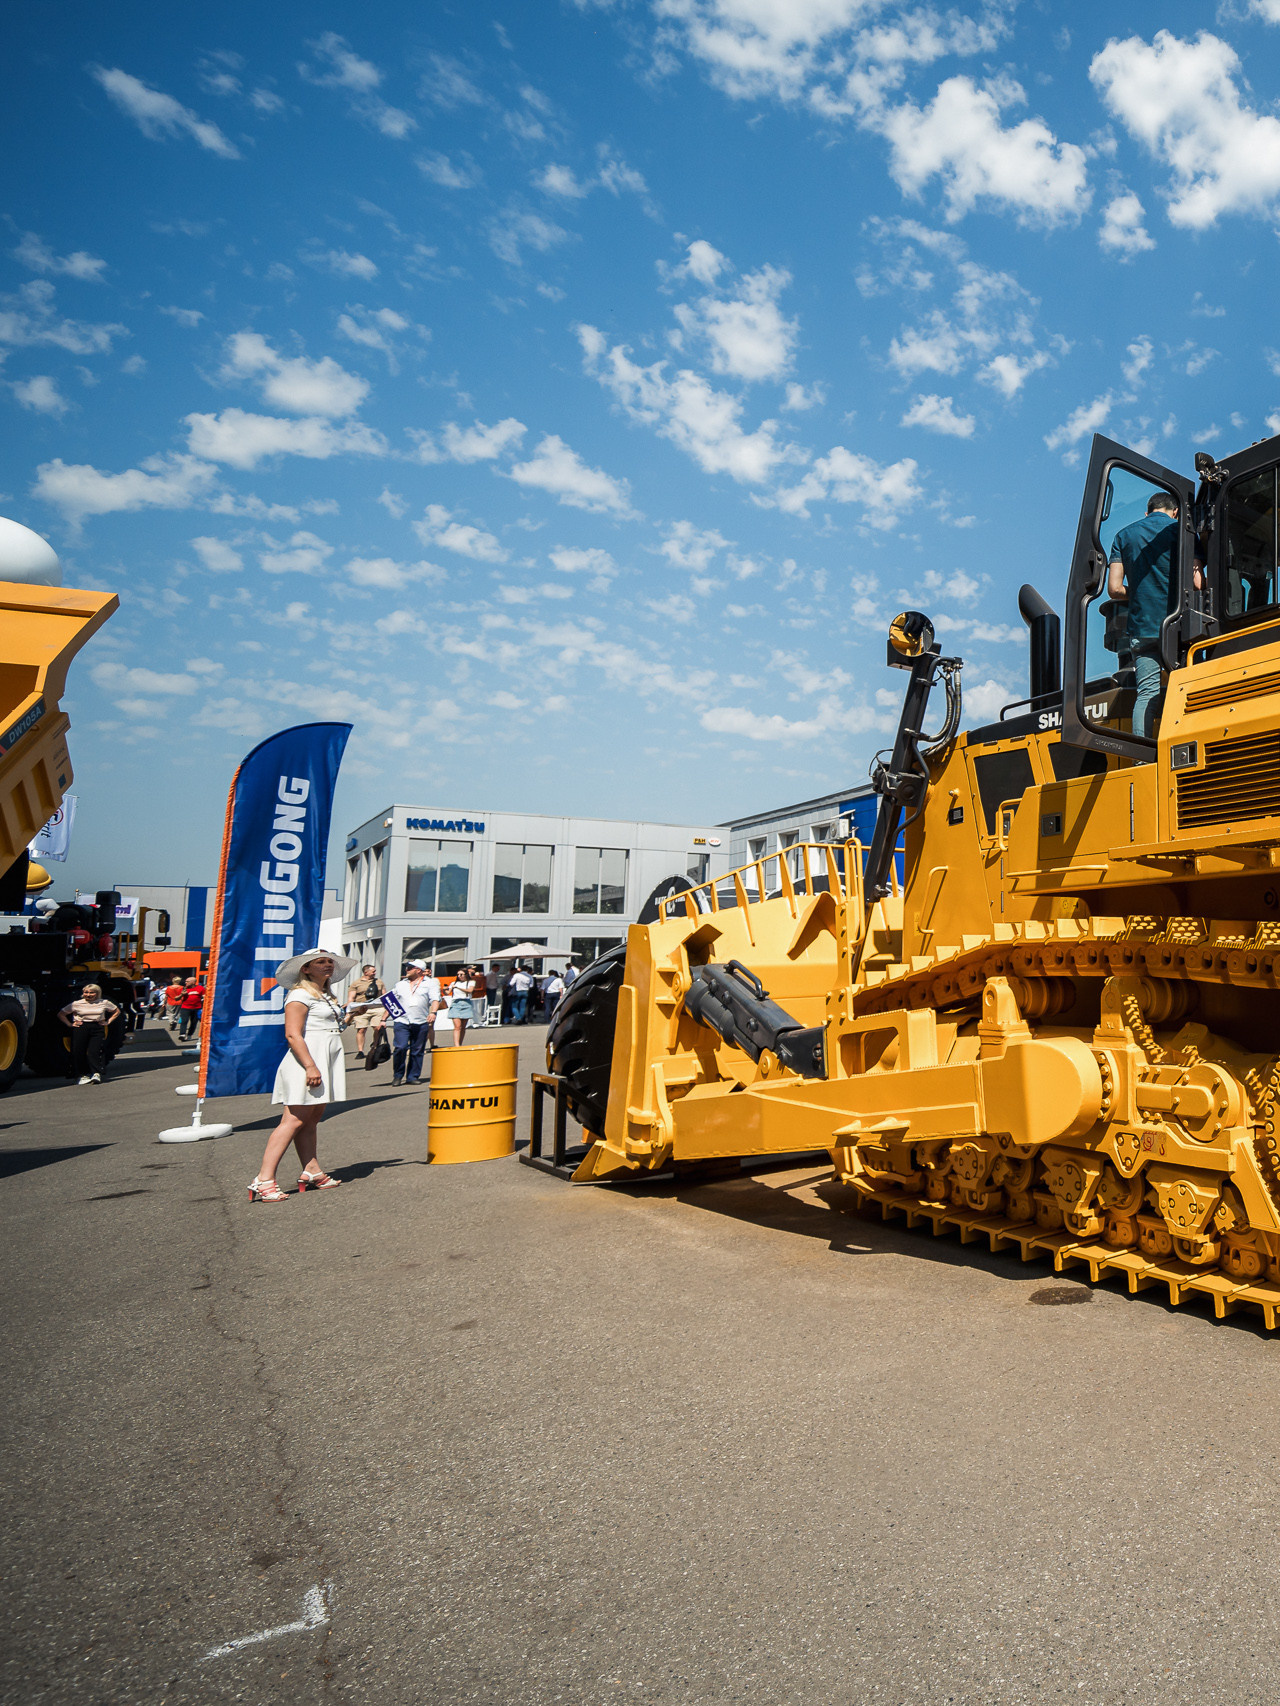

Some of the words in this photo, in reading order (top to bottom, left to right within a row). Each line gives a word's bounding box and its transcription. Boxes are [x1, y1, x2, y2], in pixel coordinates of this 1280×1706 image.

[9, 706, 42, 744] DW105A
[1038, 702, 1109, 729] SHTUI
[406, 817, 485, 833] KOMATSU
